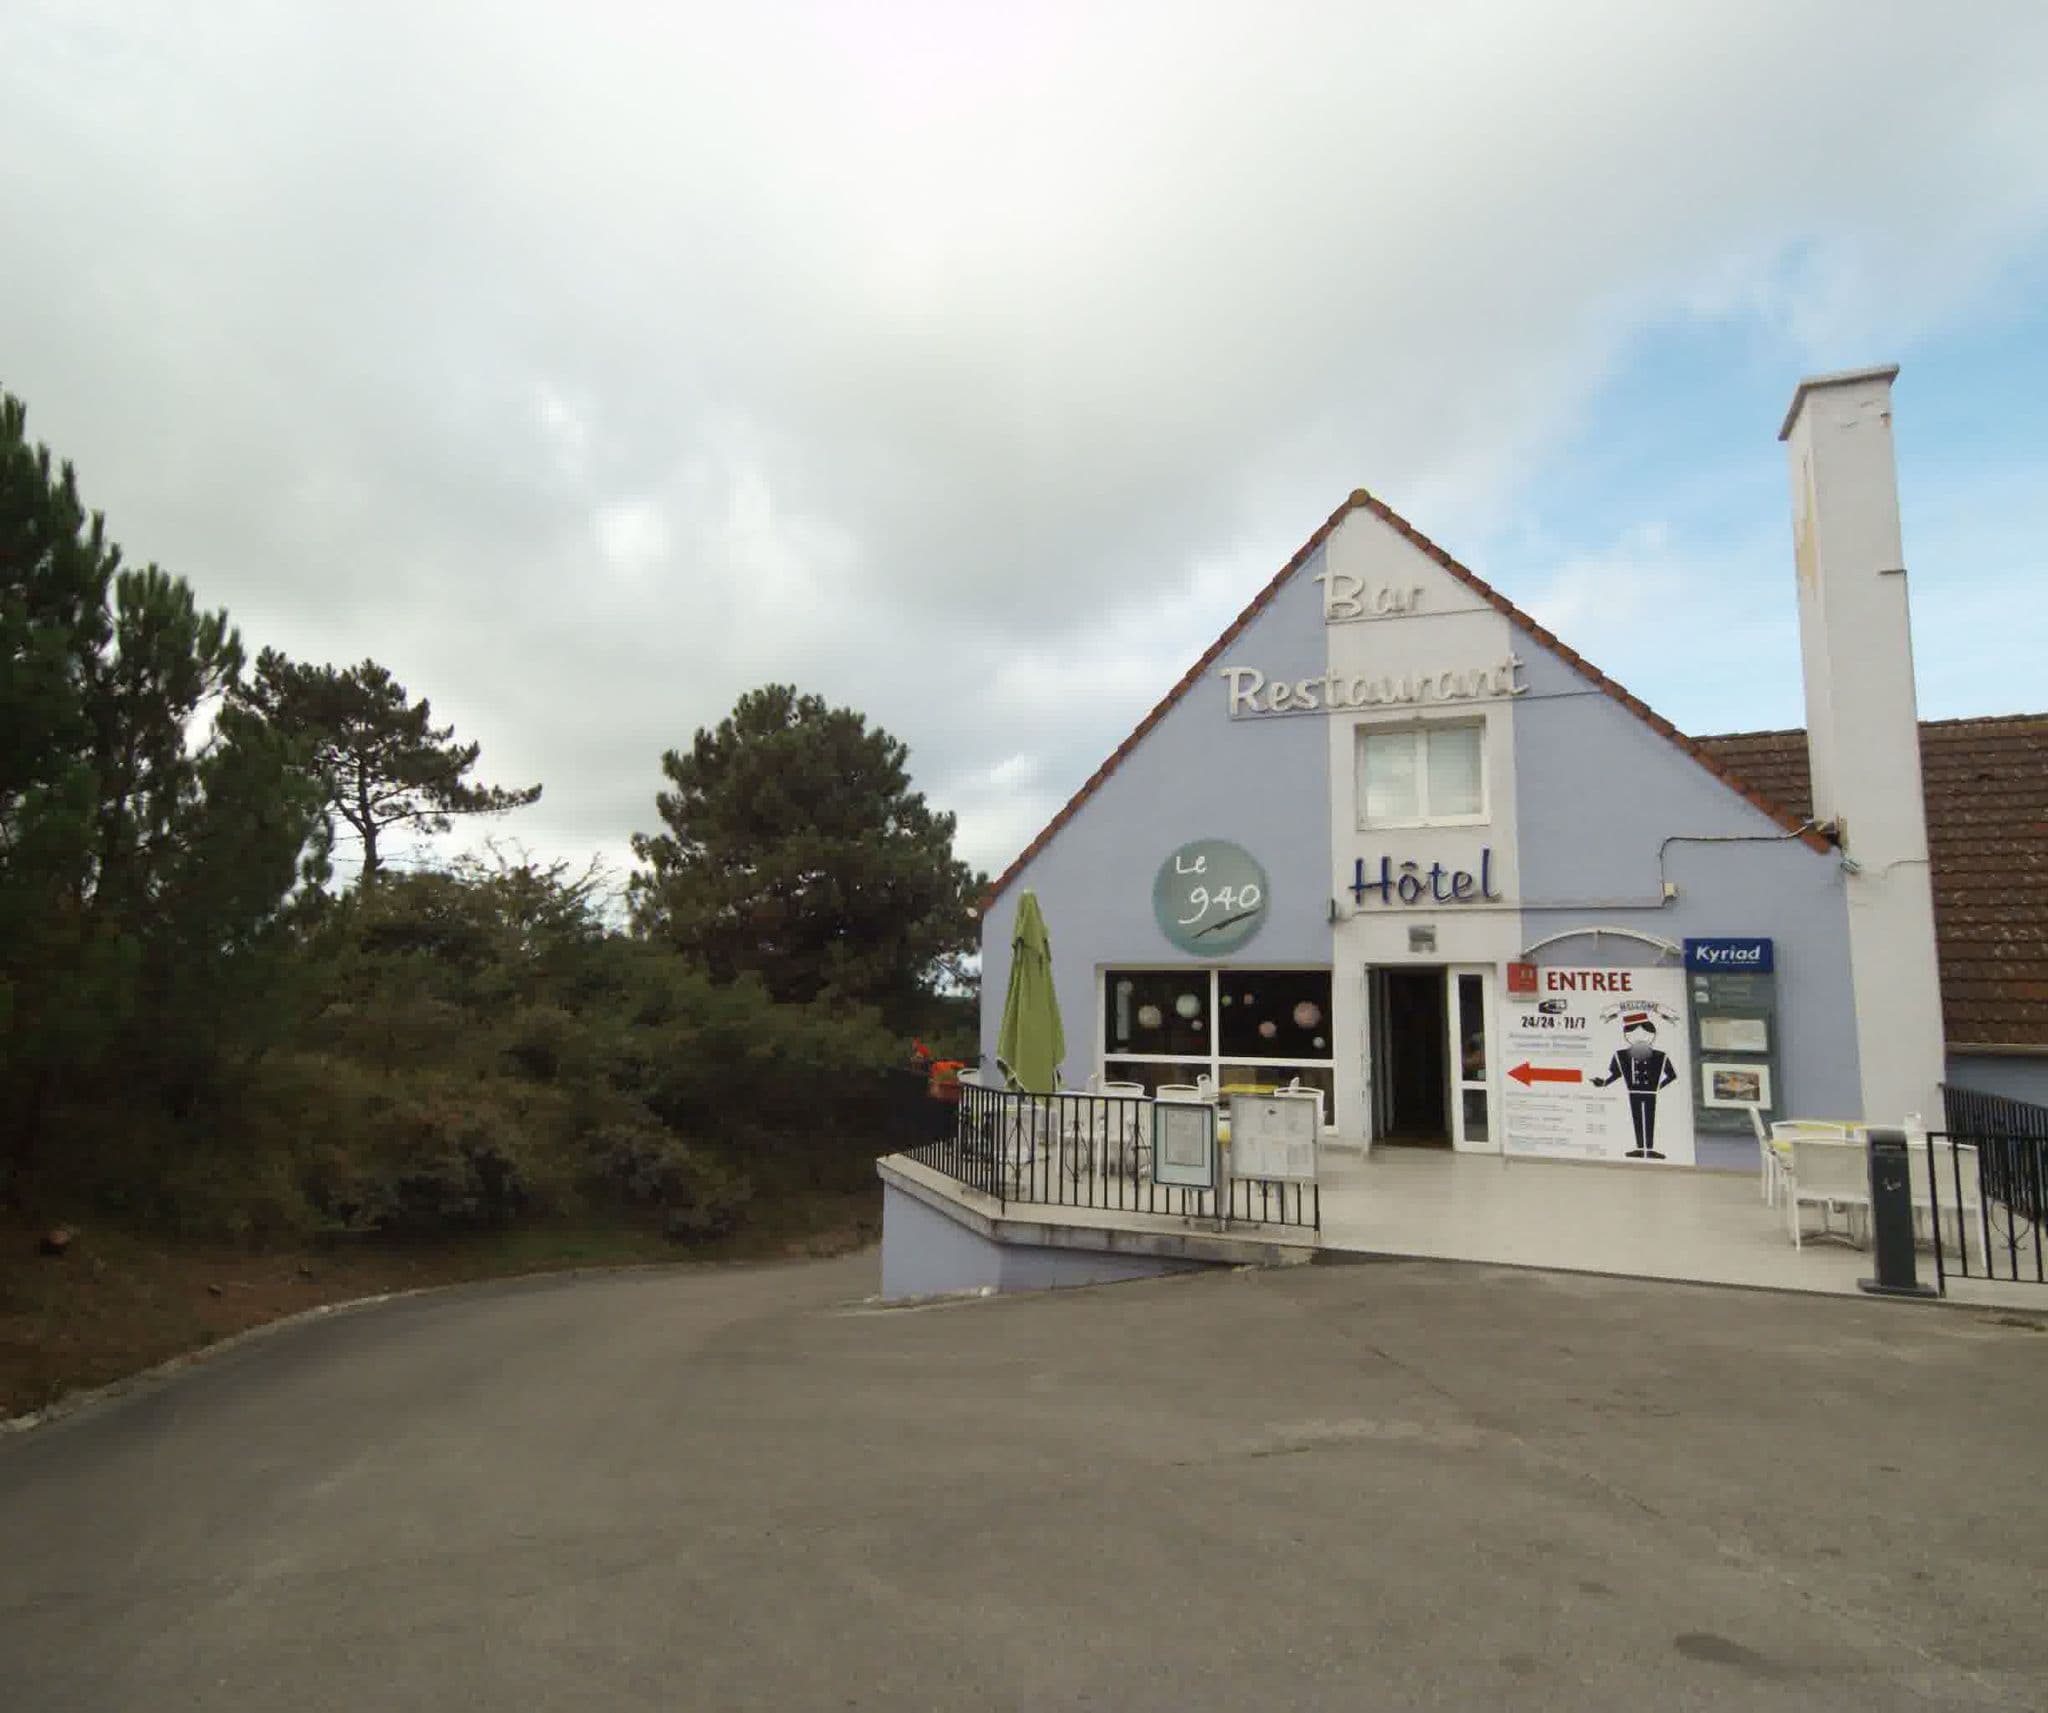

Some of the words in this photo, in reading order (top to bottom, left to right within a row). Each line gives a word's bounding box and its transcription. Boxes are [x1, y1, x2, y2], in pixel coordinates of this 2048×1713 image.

[1313, 573, 1425, 619] Bar
[1220, 651, 1529, 716] Restaurant
[1176, 855, 1206, 874] Le
[1349, 848, 1500, 905] Hôtel
[1178, 884, 1260, 924] 940
[1696, 945, 1761, 964] Kyriad
[1547, 971, 1633, 992] ENTREE
